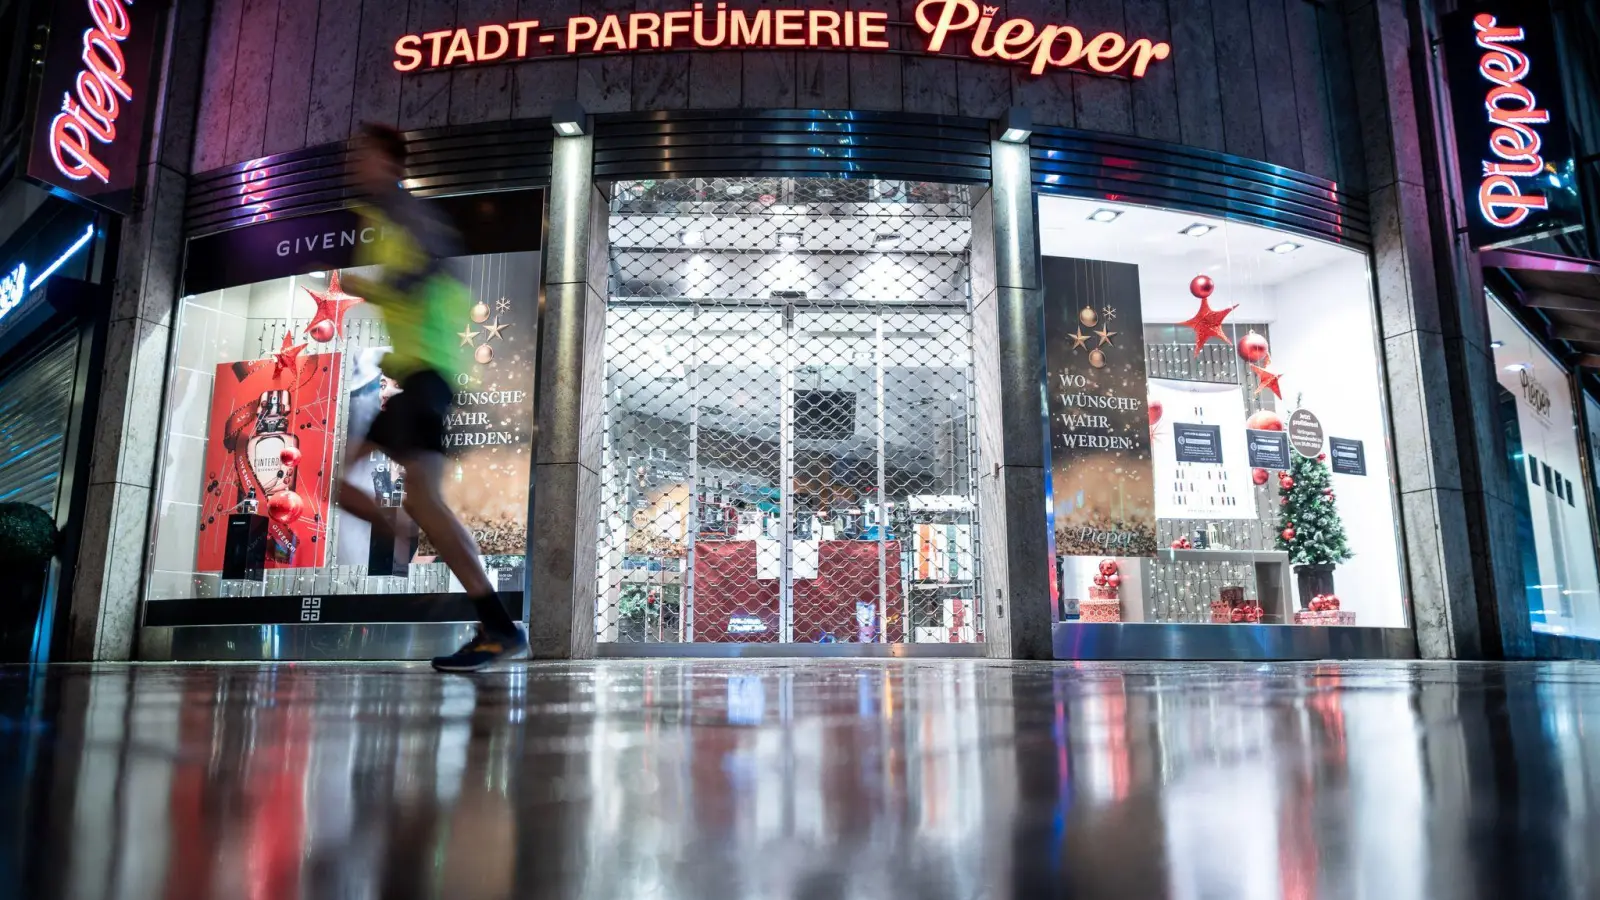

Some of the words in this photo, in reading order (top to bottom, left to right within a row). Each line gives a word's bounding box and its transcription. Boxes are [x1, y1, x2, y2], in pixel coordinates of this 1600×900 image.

[915, 0, 1170, 77] Pieper
[50, 0, 133, 184] Piepe
[1473, 12, 1549, 228] Pieper
[453, 373, 469, 386] O
[1059, 374, 1086, 388] WO
[452, 390, 523, 406] ÜNSCHE
[1060, 392, 1139, 411] WÜNSCHE
[1061, 413, 1109, 429] WAHR
[254, 457, 280, 468] L'INTERD
[1078, 526, 1134, 549] Pieper
